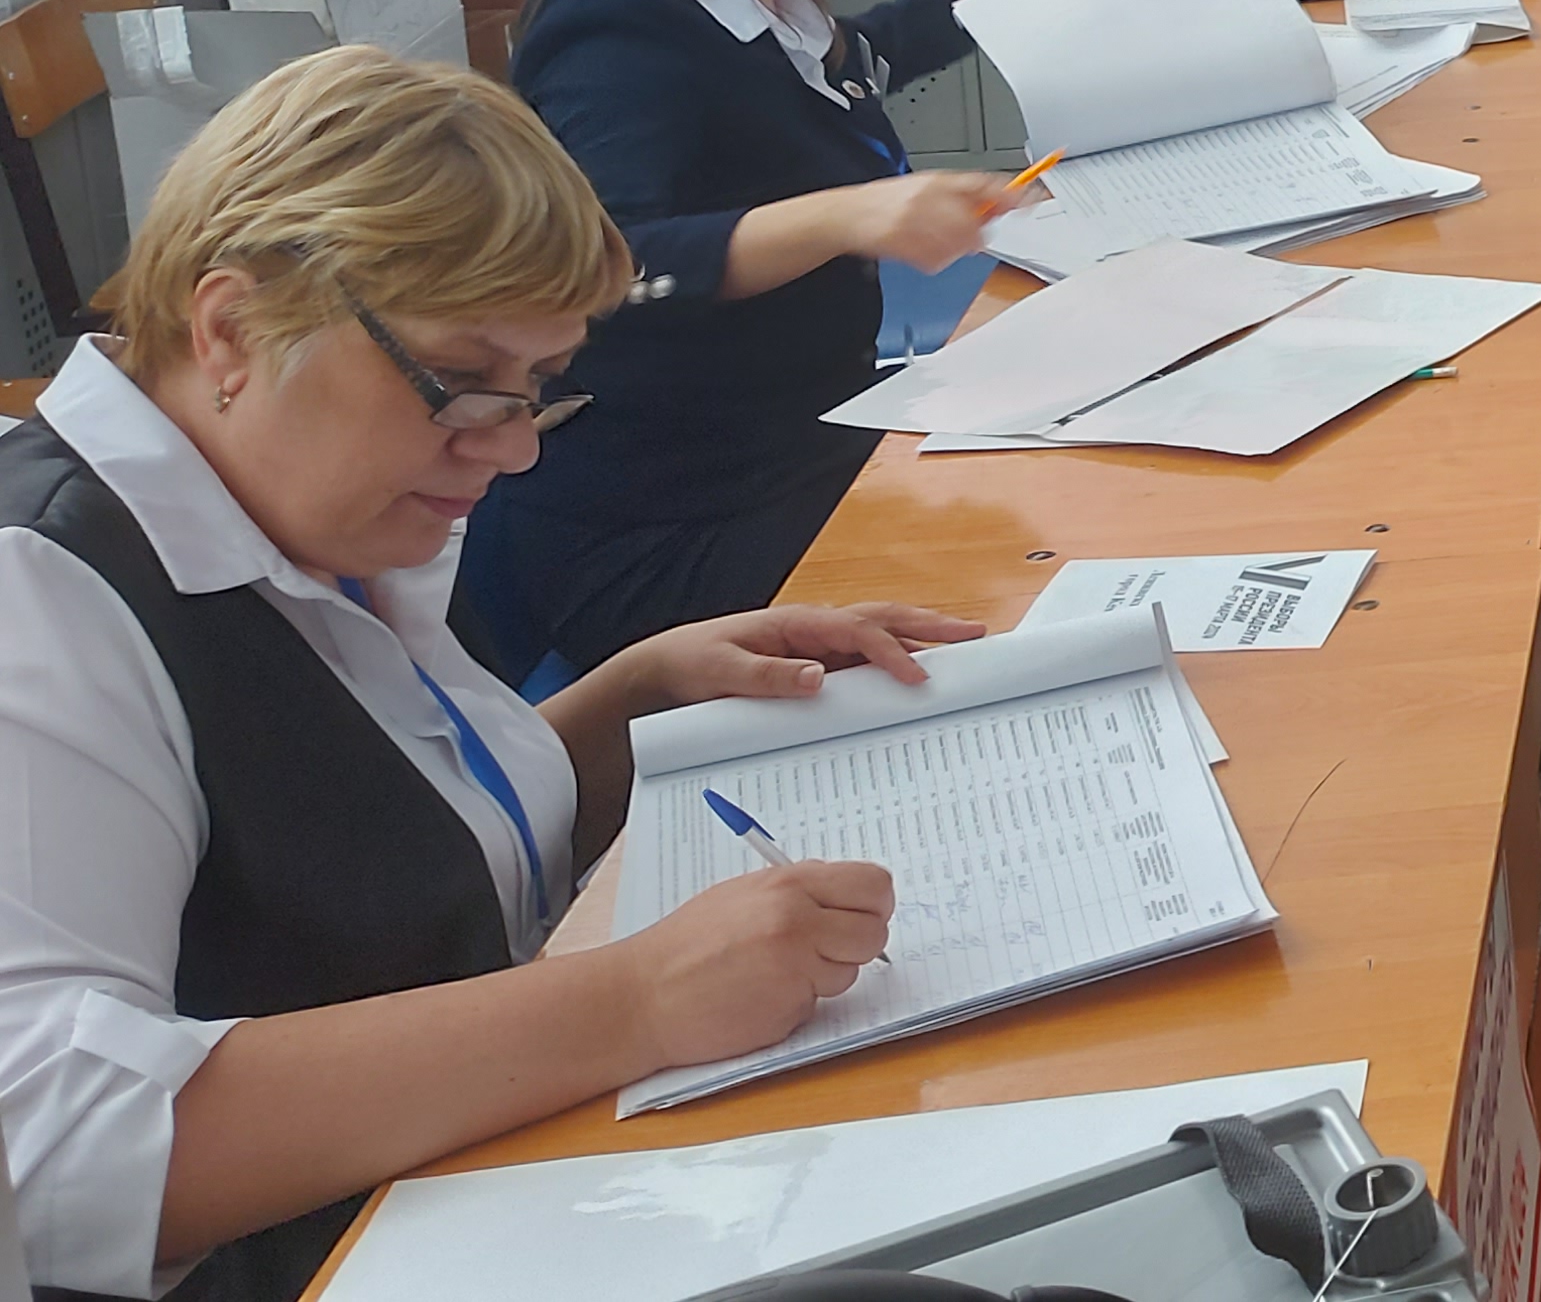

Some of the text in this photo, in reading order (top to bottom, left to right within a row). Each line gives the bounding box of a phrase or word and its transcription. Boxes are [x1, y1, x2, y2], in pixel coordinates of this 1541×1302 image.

[1230, 587, 1263, 623] РОССИИ
[1237, 590, 1283, 645] ПРЕЗИДЕНТА
[1268, 594, 1302, 633] ВЫБОРЫ
